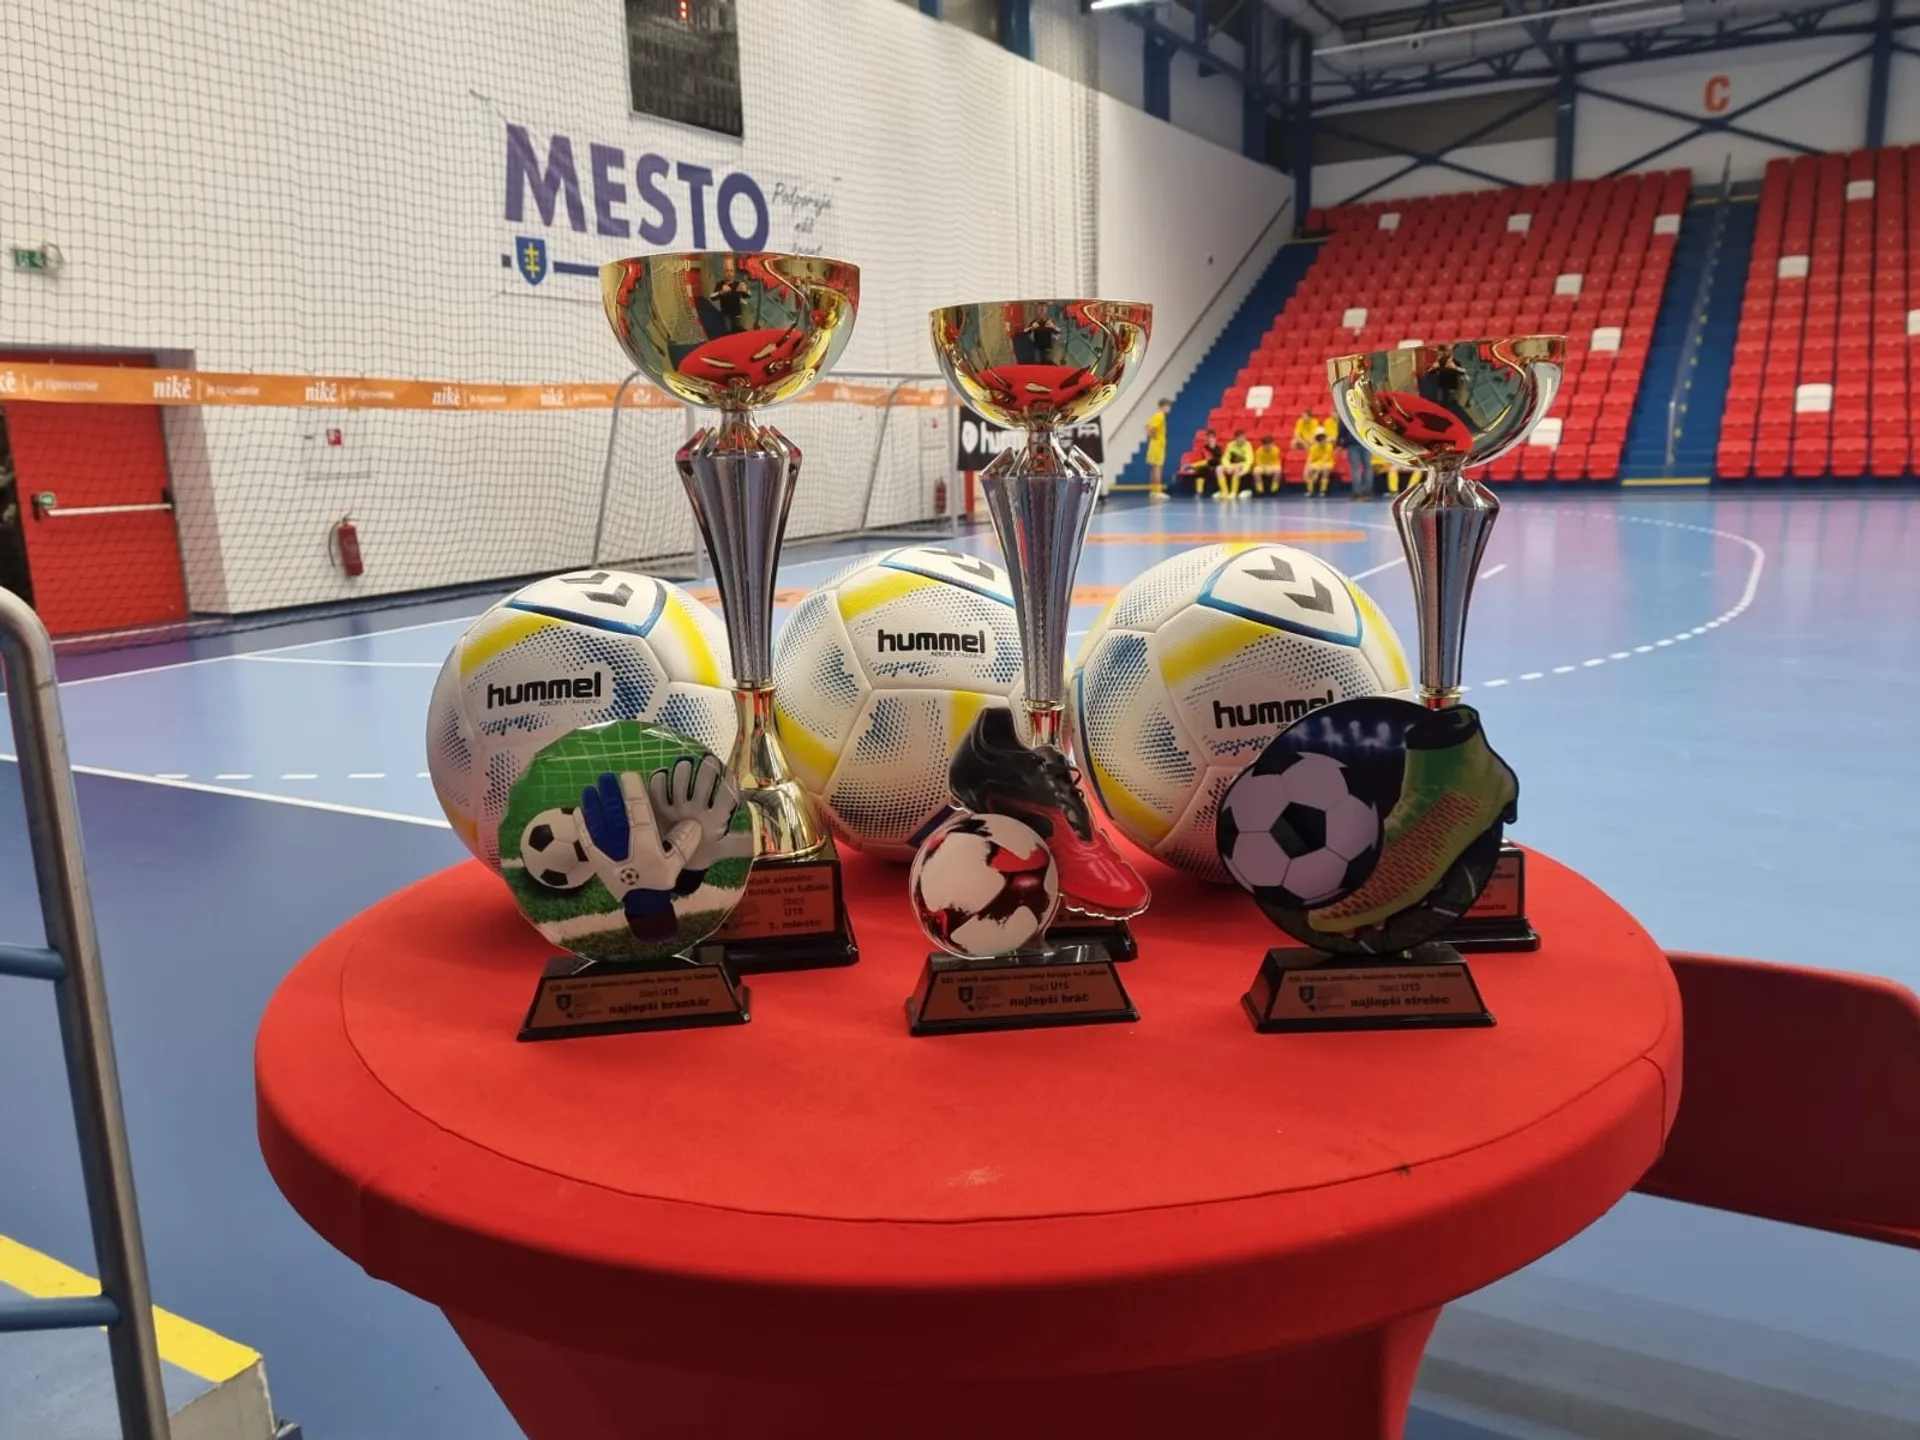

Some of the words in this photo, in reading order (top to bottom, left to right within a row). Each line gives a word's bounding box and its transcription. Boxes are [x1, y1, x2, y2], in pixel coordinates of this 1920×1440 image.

[1704, 75, 1730, 114] C
[505, 123, 769, 252] MESTO
[878, 629, 985, 653] hummel
[487, 671, 602, 709] hummel
